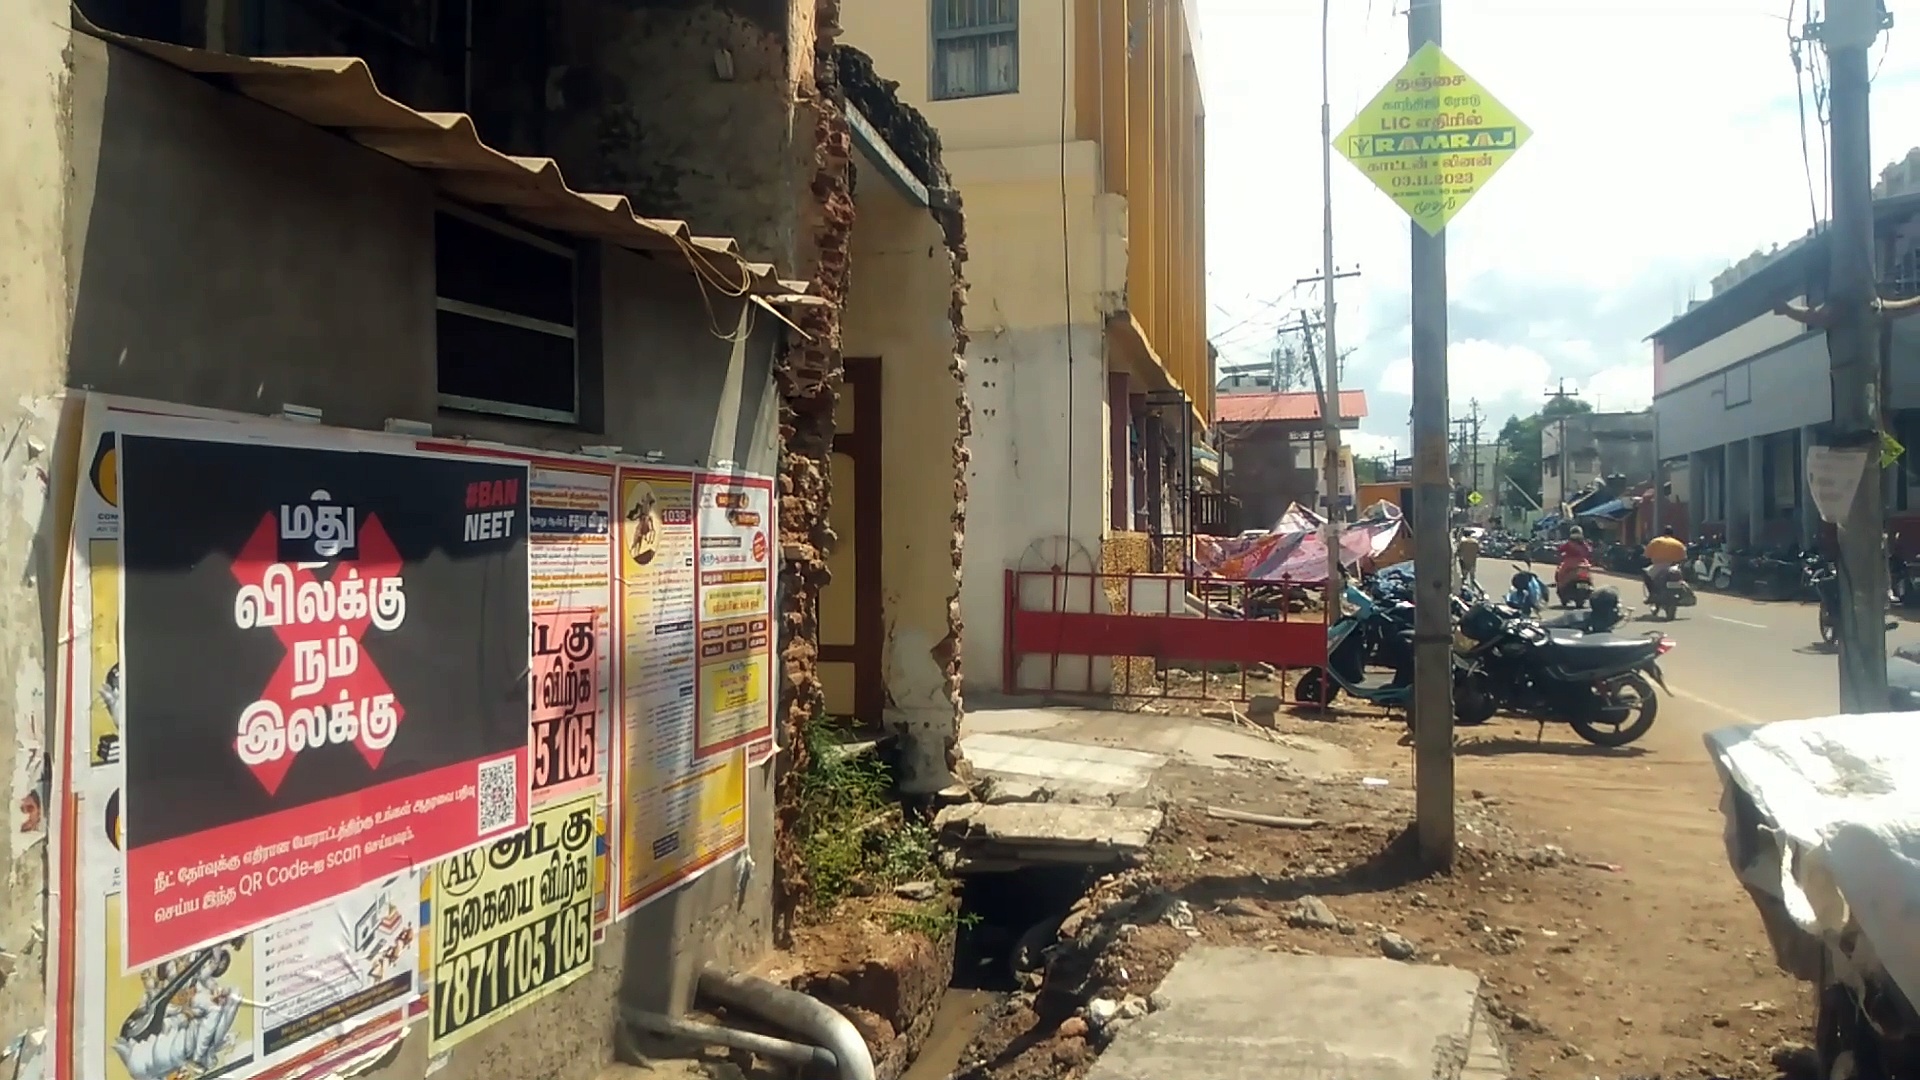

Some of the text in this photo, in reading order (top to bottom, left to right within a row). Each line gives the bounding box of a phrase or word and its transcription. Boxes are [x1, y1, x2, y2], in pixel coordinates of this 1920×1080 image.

[1395, 72, 1466, 92] தஞ்சை
[1375, 131, 1513, 152] RAMRAJ
[1381, 109, 1482, 131] LIC எதிரில்
[1368, 156, 1427, 171] காட்டன்
[1392, 172, 1473, 187] 03.11.2023
[466, 478, 518, 508] #BAN
[663, 510, 687, 523] 1038
[281, 505, 354, 556] மது
[464, 510, 514, 541] NEET
[235, 563, 406, 631] விலக்கு
[291, 624, 358, 700] நம்
[237, 689, 397, 765] இலக்கு
[555, 714, 593, 780] 105
[154, 785, 476, 895] நீட் தேர்வுக்கு எதிரான போராட்டத்திற்கு உங்கள் ஆதரவை பதிவு
[489, 808, 592, 870] அடகு
[154, 898, 199, 923] செய்ய
[202, 886, 236, 910] இந்த
[239, 872, 262, 896] QR
[266, 859, 324, 886] Code-ஐ
[327, 844, 361, 868] scan
[446, 849, 478, 889] AK
[443, 850, 587, 958] நகையை விற்க
[437, 940, 499, 1035] 7871
[504, 920, 546, 999] 105
[551, 902, 588, 975] 105
